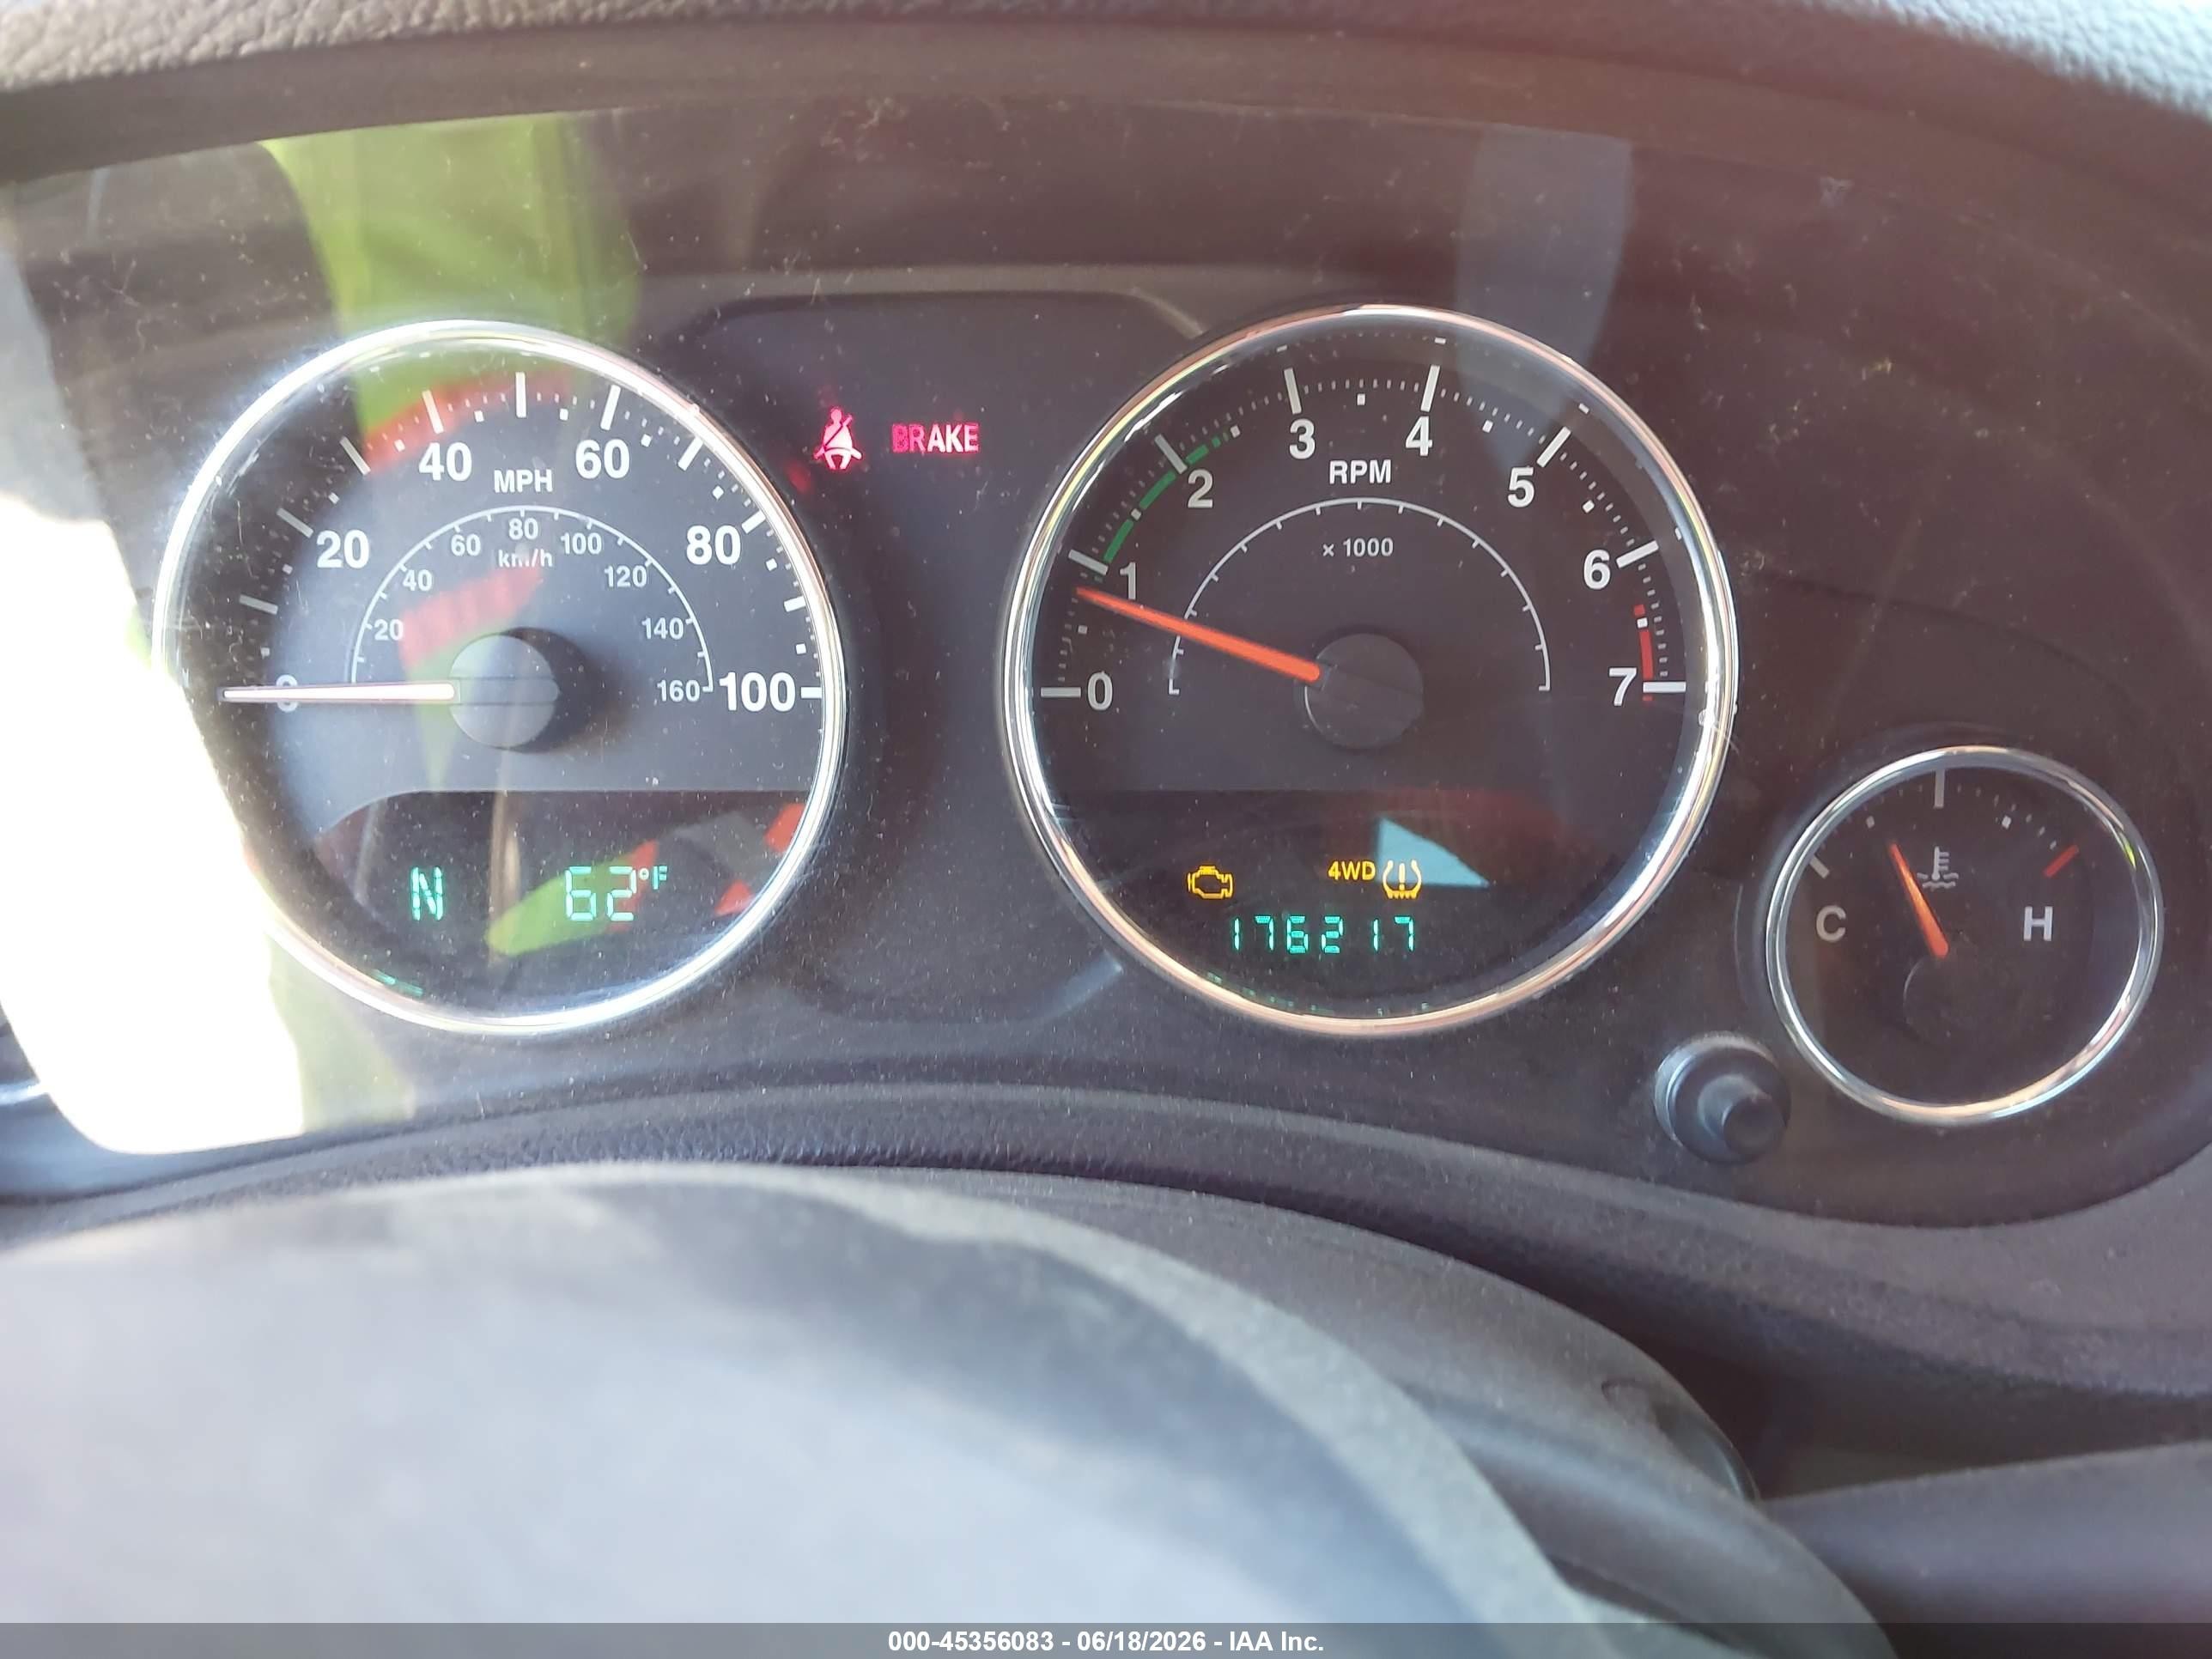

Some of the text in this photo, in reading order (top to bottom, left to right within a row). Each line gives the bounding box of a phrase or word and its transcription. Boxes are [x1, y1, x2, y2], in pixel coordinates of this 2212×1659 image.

[892, 423, 979, 453] BRAKE
[1289, 419, 1316, 459] 3
[1406, 416, 1433, 455] 4
[419, 442, 471, 482] 40
[575, 440, 630, 479] 60
[1329, 460, 1391, 484] RPM
[494, 470, 554, 493] MPH
[1188, 471, 1213, 508] 2
[1508, 468, 1534, 507] 5
[452, 535, 481, 556] 60
[508, 517, 539, 540] 80
[561, 534, 603, 555] 100
[686, 526, 741, 565] 80
[317, 530, 369, 568] 20
[1342, 538, 1394, 558] 1000
[403, 569, 433, 591] 40
[605, 567, 647, 587] 120
[1119, 562, 1137, 599] 1
[1583, 550, 1610, 589] 6
[374, 620, 404, 641] 20
[642, 619, 684, 640] 140
[657, 682, 700, 702] 160
[719, 672, 795, 712] 100
[1086, 672, 1114, 712] 0
[1608, 667, 1637, 706] 7
[1328, 861, 1376, 881] 4WD
[411, 866, 444, 921] N
[1233, 915, 1415, 954] 176217
[1816, 906, 1846, 942] C
[2023, 907, 2053, 941] H
